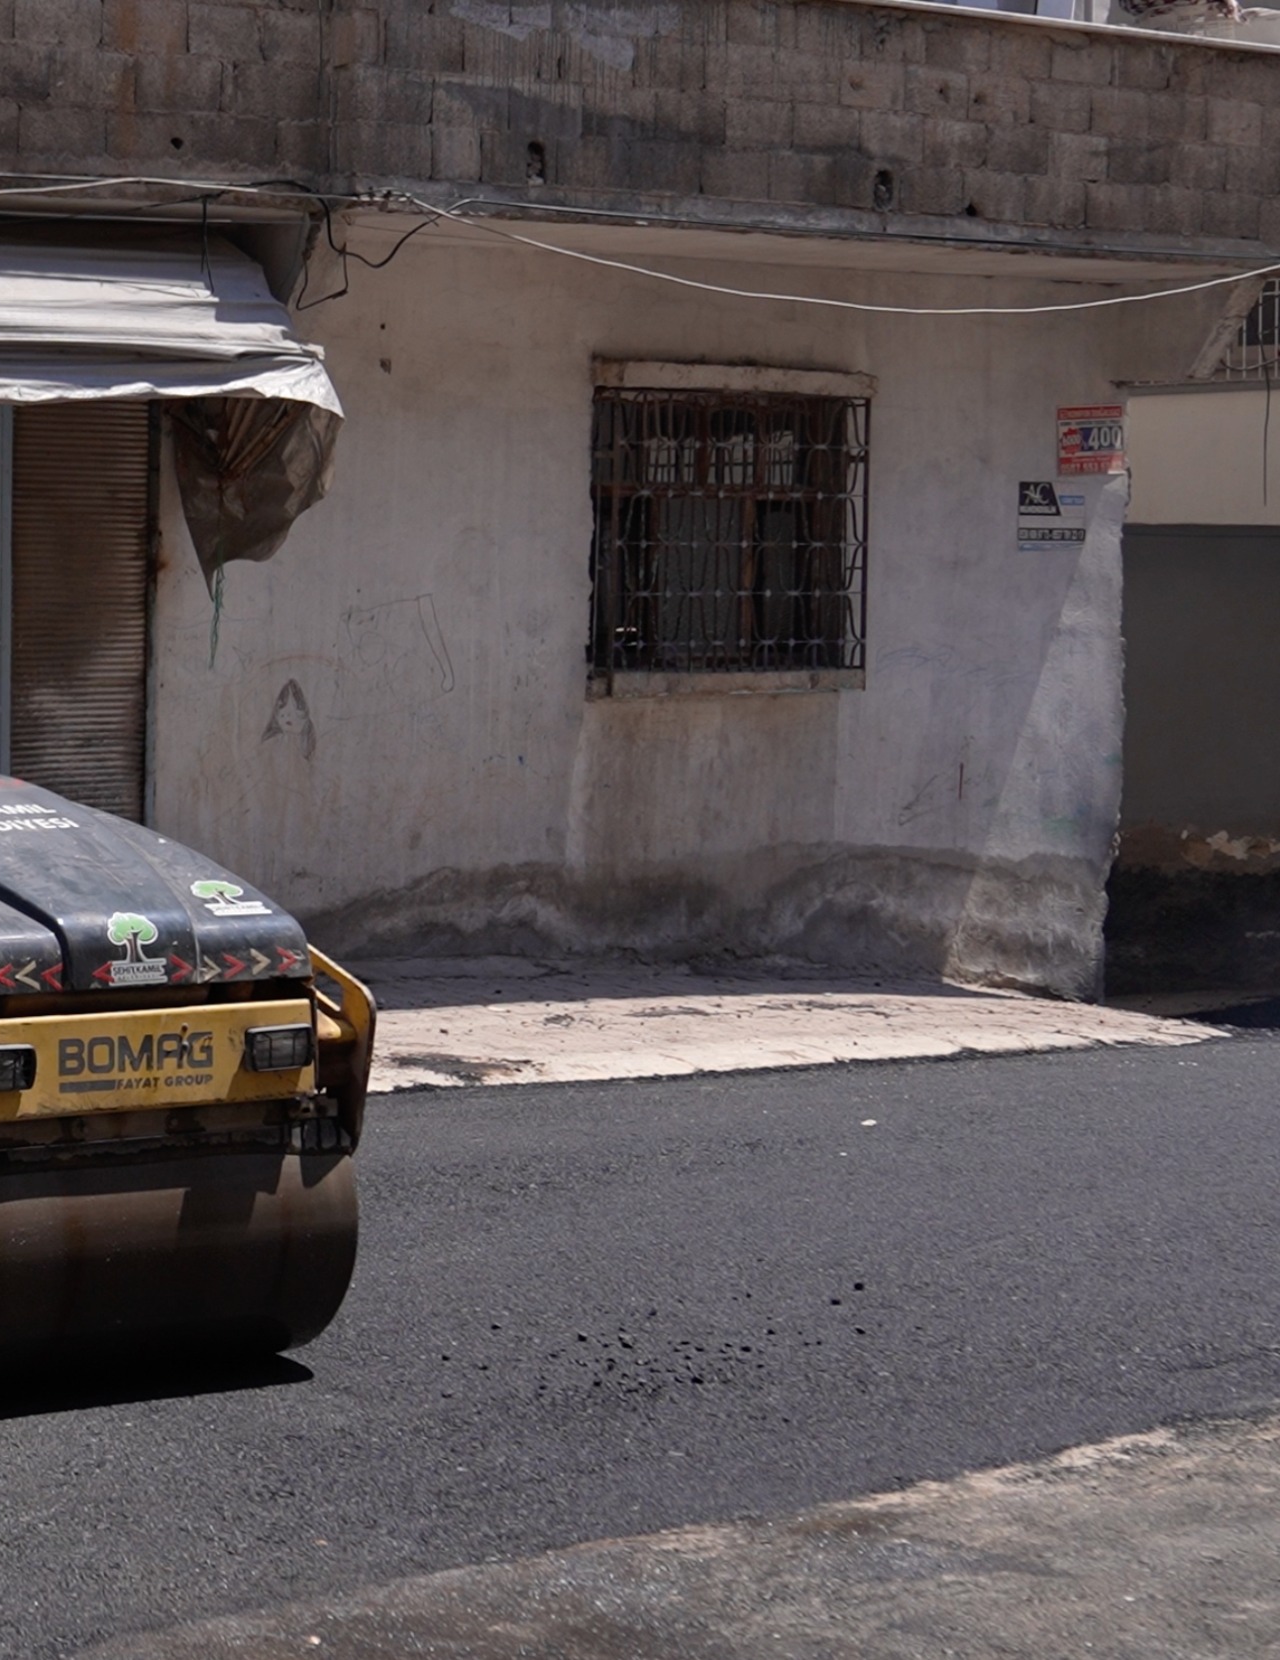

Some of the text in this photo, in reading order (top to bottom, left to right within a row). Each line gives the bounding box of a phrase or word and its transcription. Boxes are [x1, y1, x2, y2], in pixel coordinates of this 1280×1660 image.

[58, 1031, 214, 1077] BOMAG
[116, 1074, 213, 1090] FAYAT GROUP
